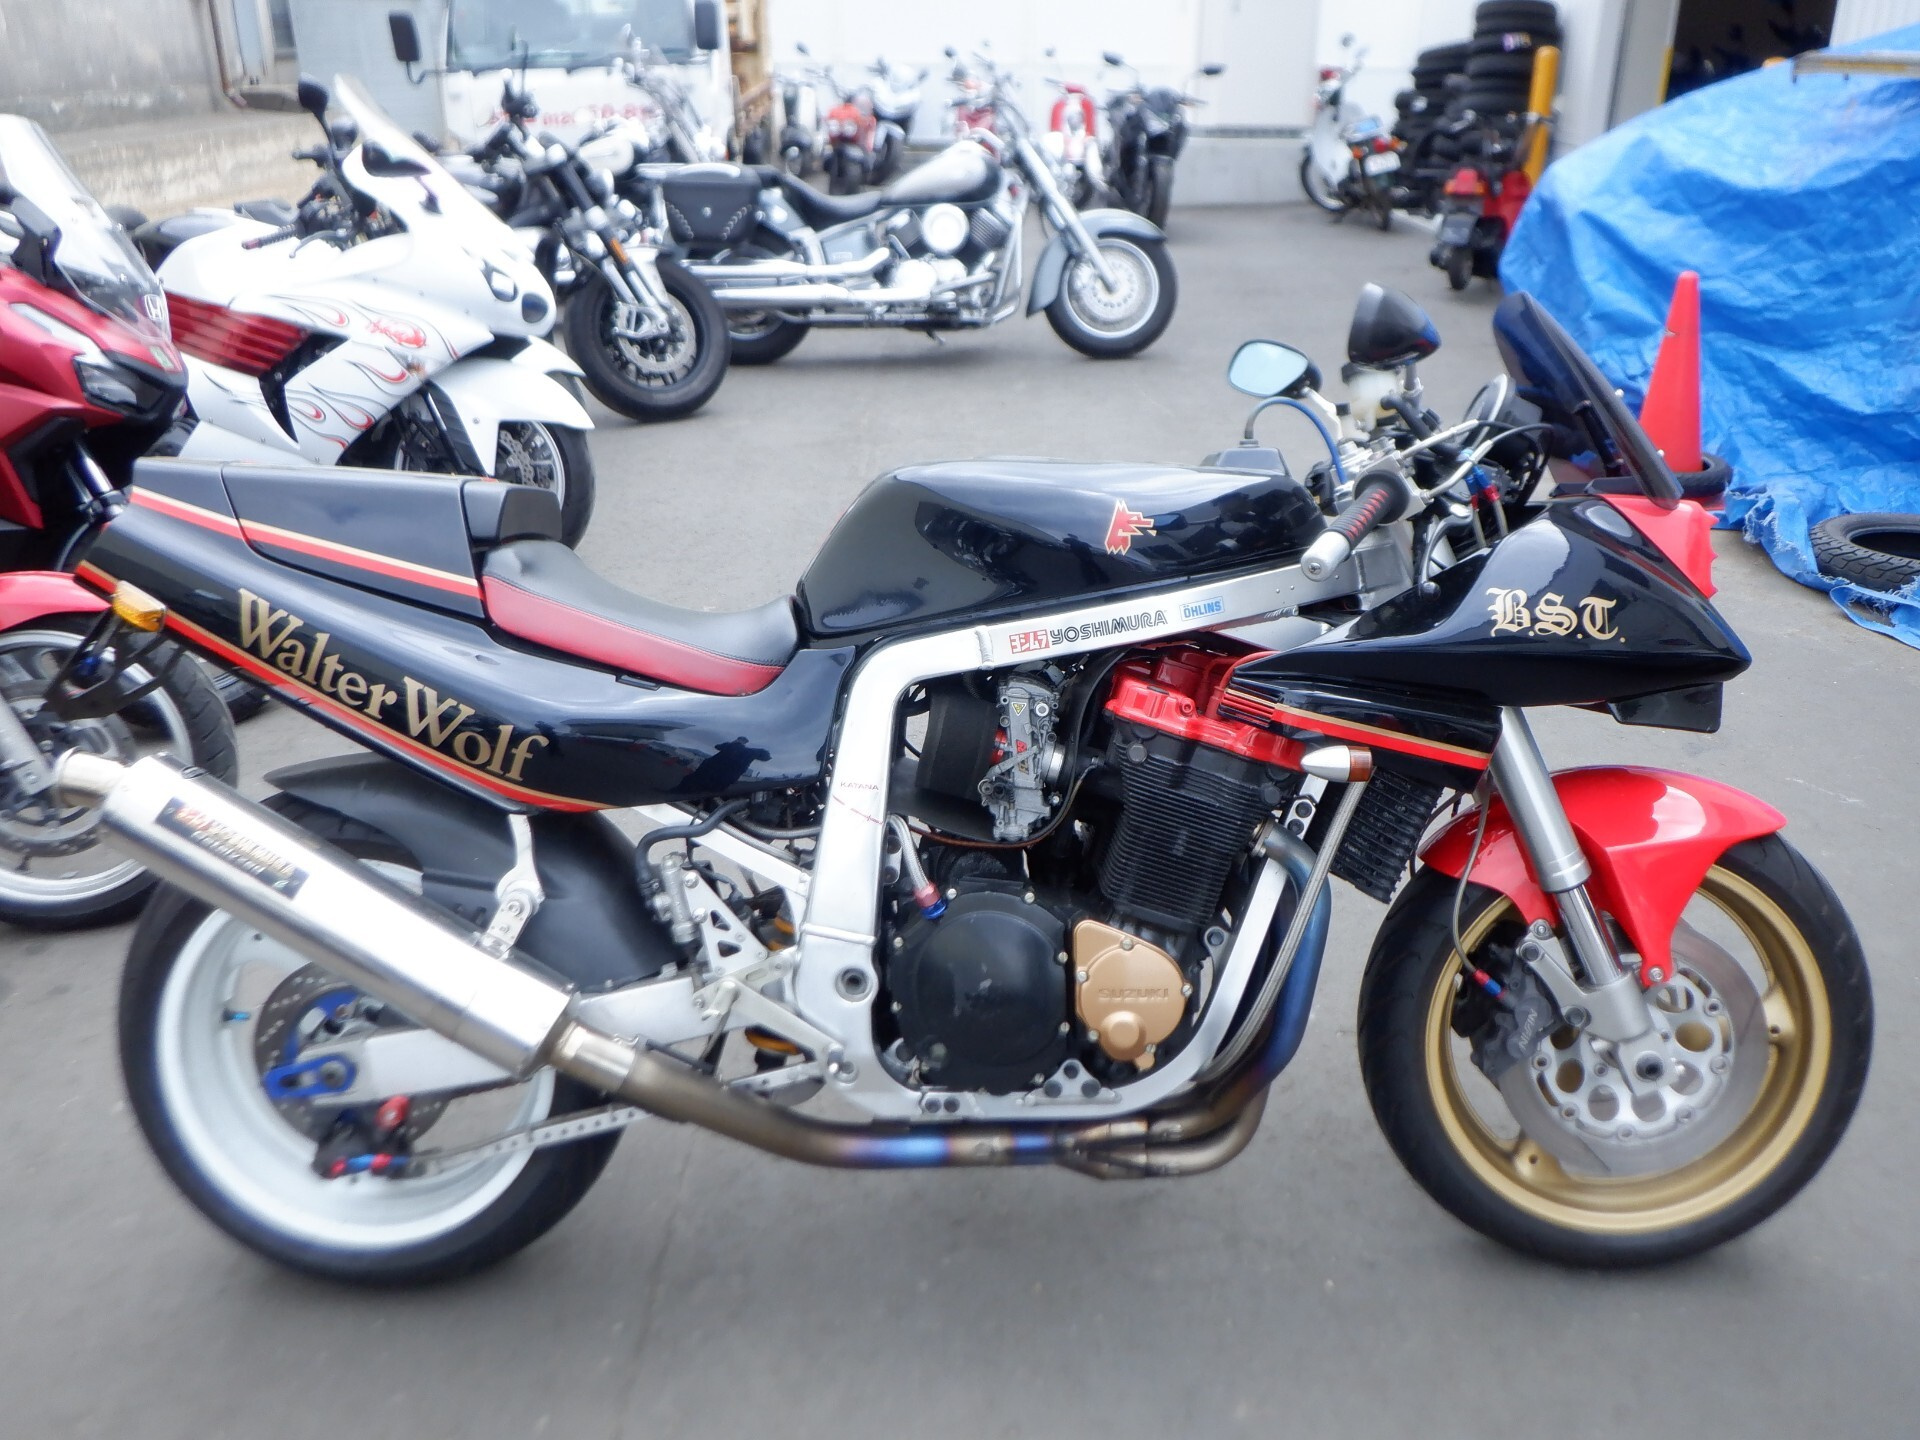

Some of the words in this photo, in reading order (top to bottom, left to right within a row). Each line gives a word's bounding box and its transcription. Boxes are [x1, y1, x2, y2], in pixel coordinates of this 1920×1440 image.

[1183, 600, 1222, 619] ÖHLINS
[1485, 587, 1626, 643] B.S.T.
[1009, 629, 1050, 654] ヨシムラ
[1050, 610, 1168, 646] YOSHIMURA
[238, 587, 398, 720] Walter
[403, 675, 550, 782] Wolf
[840, 781, 879, 791] KATANA
[1098, 988, 1169, 1001] SUZUKI
